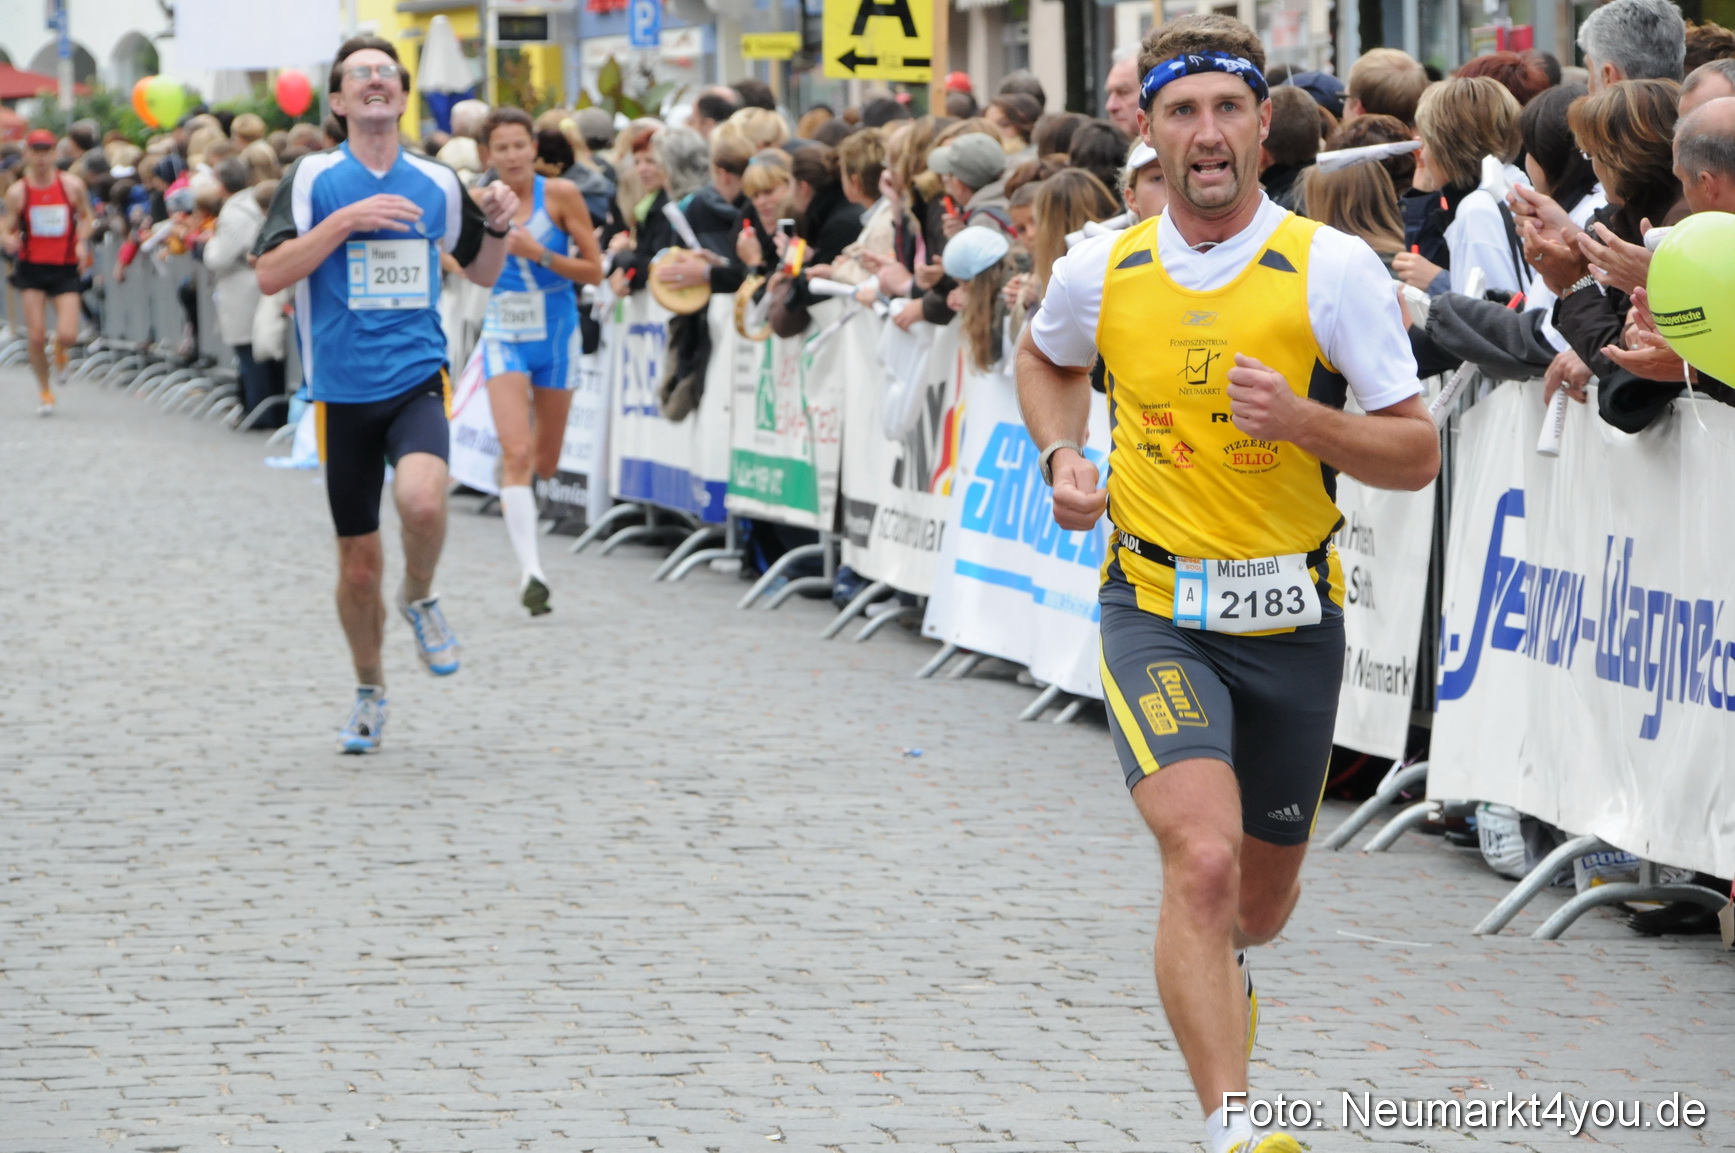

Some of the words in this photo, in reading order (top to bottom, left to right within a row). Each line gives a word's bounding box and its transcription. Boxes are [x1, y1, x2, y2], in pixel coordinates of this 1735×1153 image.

[371, 248, 396, 260] Hans
[373, 266, 420, 285] 2037
[1142, 411, 1174, 427] Seidl
[1223, 439, 1279, 455] PIZZERIA
[1233, 453, 1274, 465] ELIO
[1118, 531, 1142, 555] TADL
[1217, 556, 1280, 577] Michael
[1186, 587, 1194, 602] A
[1219, 585, 1306, 619] 2183
[1158, 668, 1200, 719] Run!
